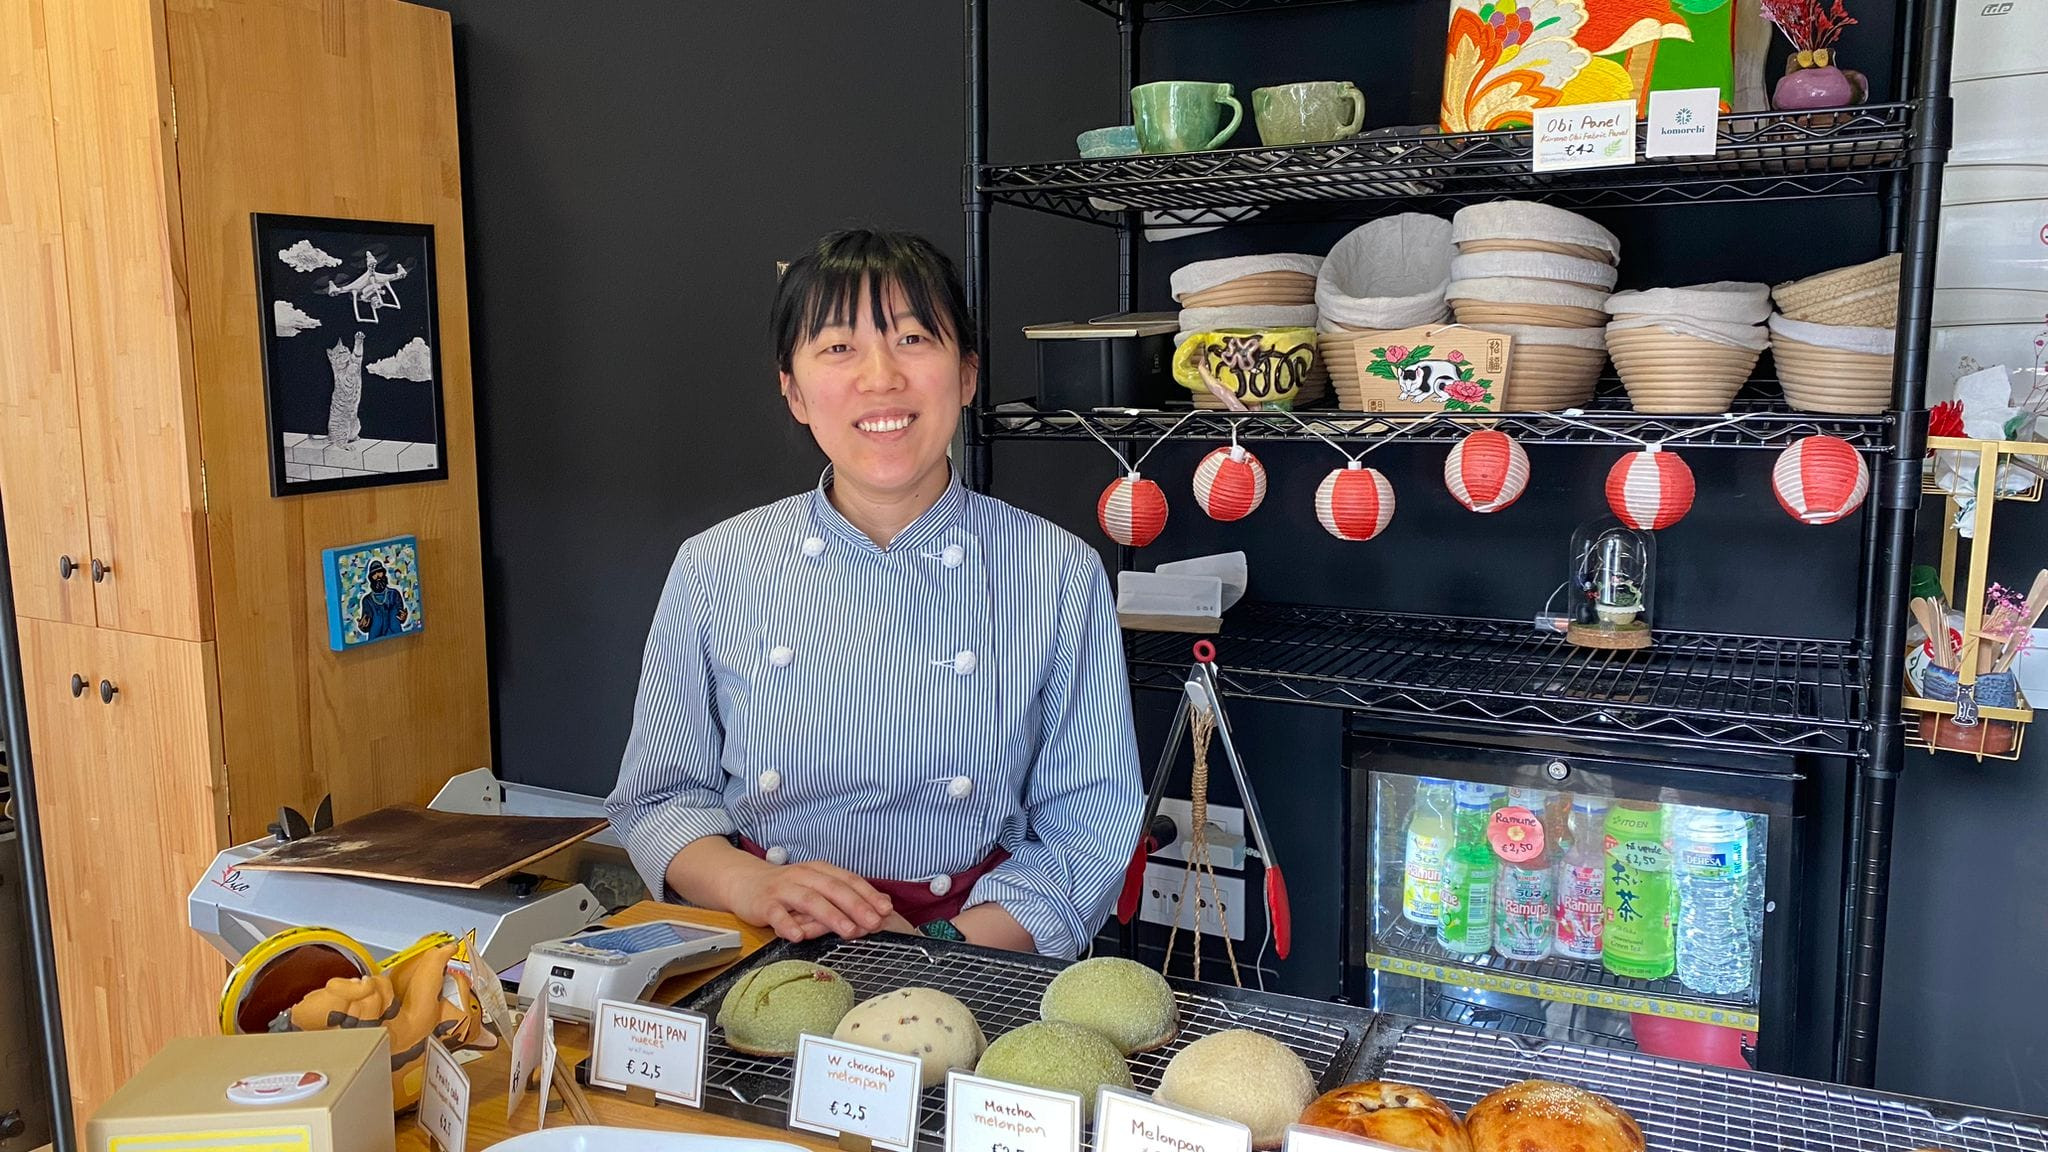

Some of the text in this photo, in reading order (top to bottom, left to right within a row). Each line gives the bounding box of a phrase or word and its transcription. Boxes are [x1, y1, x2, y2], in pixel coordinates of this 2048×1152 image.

[1547, 114, 1620, 133] Obi Panel
[1564, 143, 1595, 156] €42
[1495, 812, 1537, 827] Ramune
[1686, 854, 1722, 867] DEHESA
[1407, 862, 1441, 881] Ramun
[1564, 896, 1603, 914] Ramun
[614, 1013, 687, 1041] KURUMI PAN
[632, 1035, 664, 1049] nueces
[828, 1055, 895, 1082] W chocochip
[827, 1070, 888, 1092] melonpan
[984, 1100, 1036, 1120] Matcha
[973, 1113, 1046, 1138] melonpan
[1132, 1119, 1205, 1152] Melonpan
